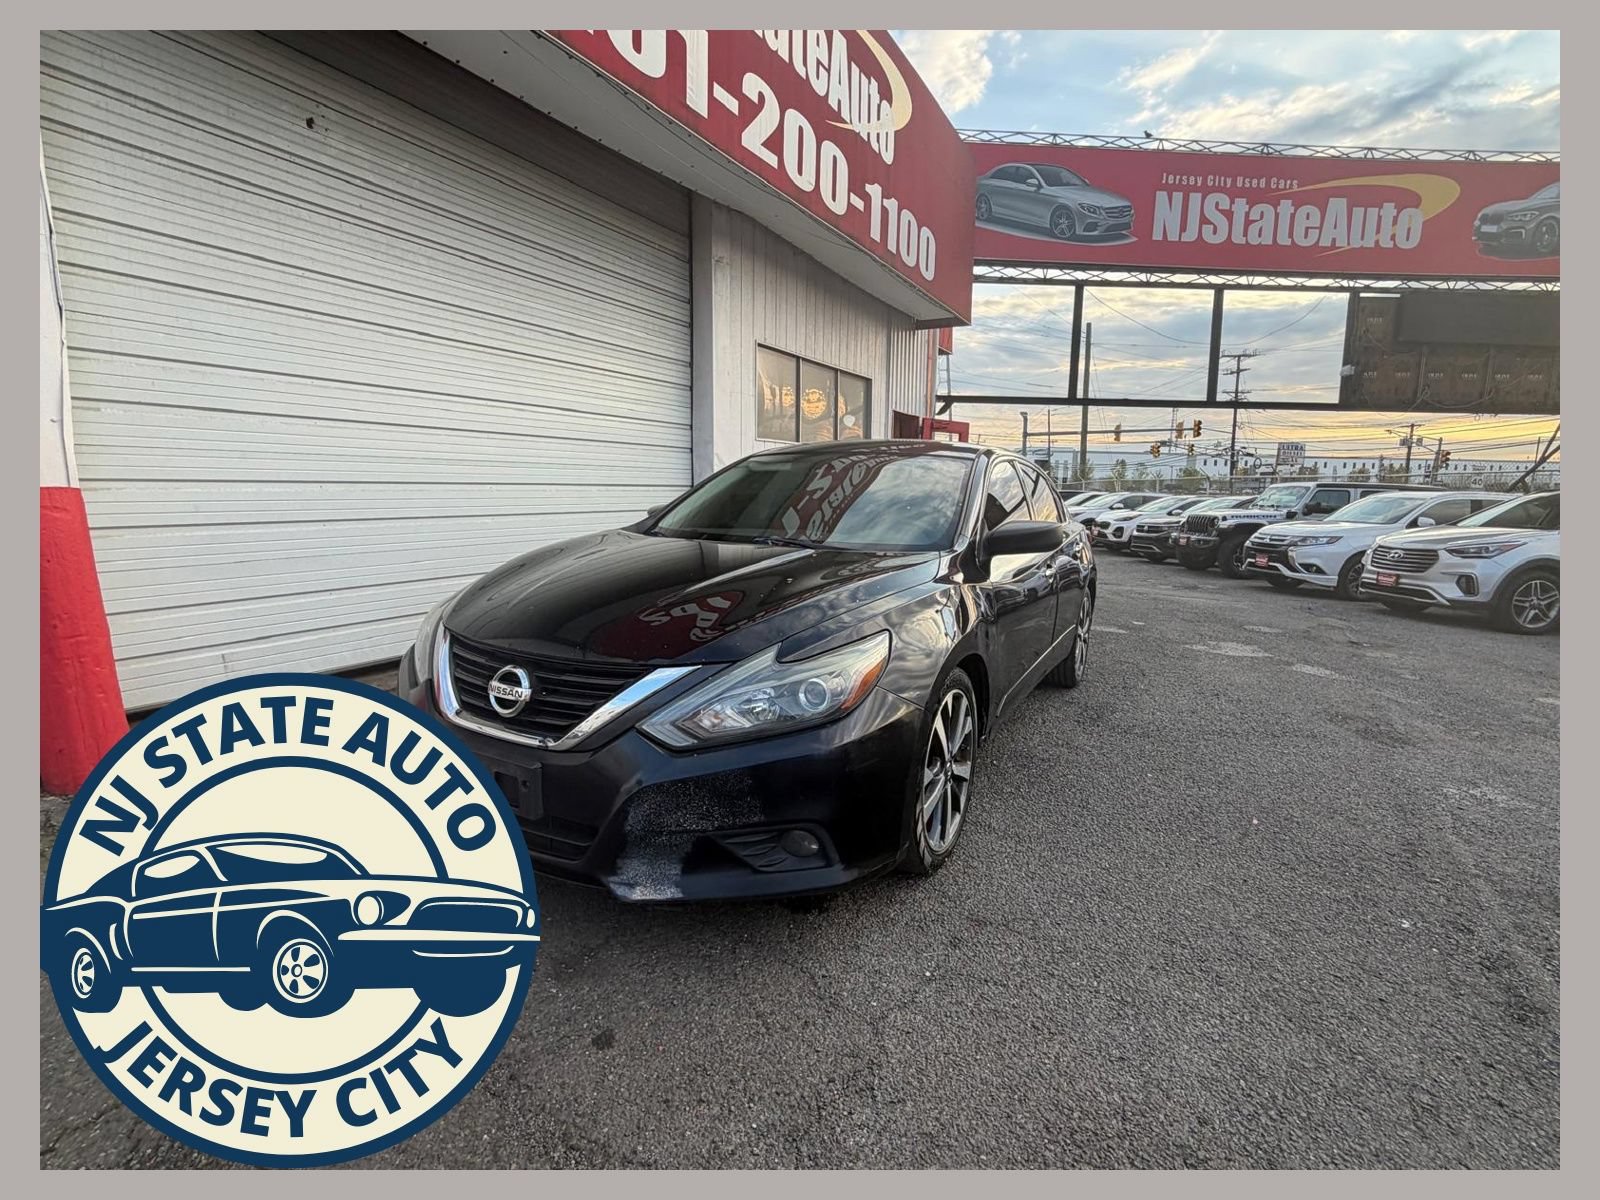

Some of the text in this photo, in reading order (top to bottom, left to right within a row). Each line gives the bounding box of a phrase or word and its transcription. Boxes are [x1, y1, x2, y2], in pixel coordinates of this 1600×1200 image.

[1162, 173, 1299, 190] Jersey City Used Cars
[1153, 190, 1425, 249] NJStateAuto
[490, 684, 523, 699] NISSAN
